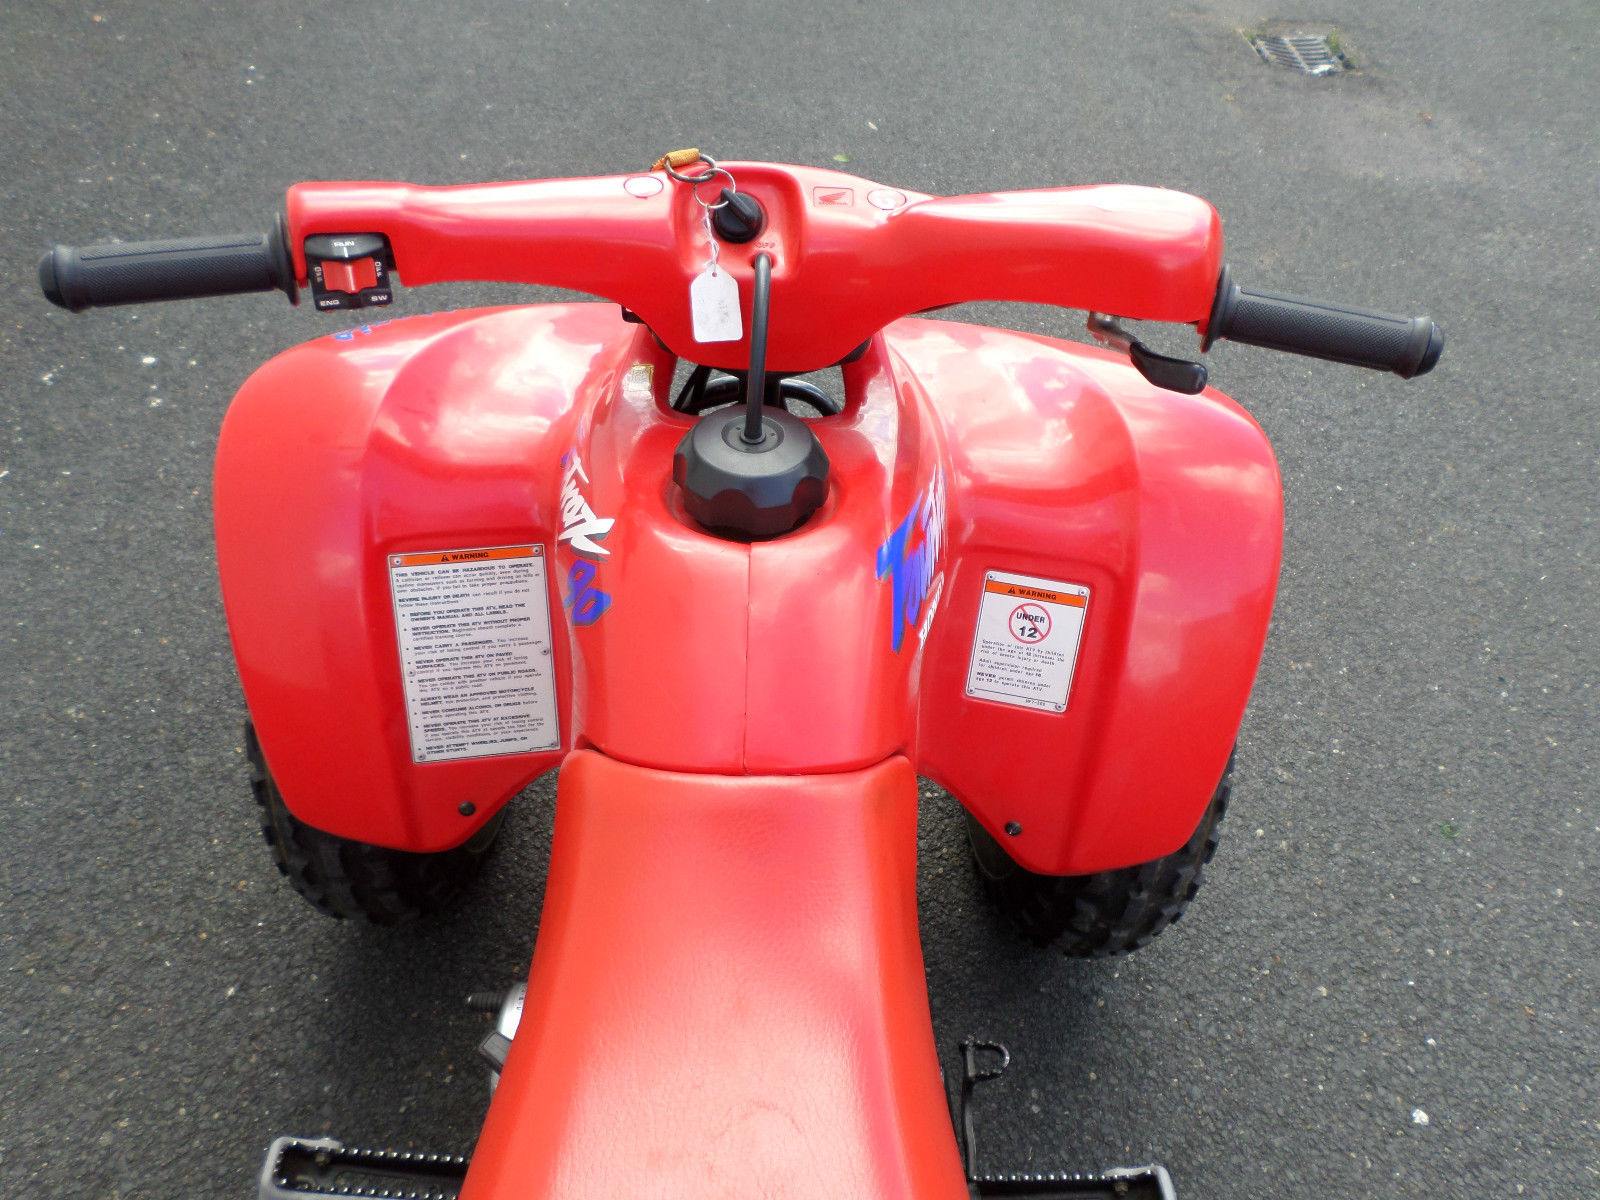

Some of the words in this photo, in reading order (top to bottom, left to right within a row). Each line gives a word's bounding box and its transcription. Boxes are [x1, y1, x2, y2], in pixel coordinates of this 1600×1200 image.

[452, 552, 489, 561] WARNING
[562, 559, 612, 624] 90
[1018, 588, 1057, 600] WARNING
[1016, 612, 1046, 624] UNDER
[1019, 626, 1038, 638] 12
